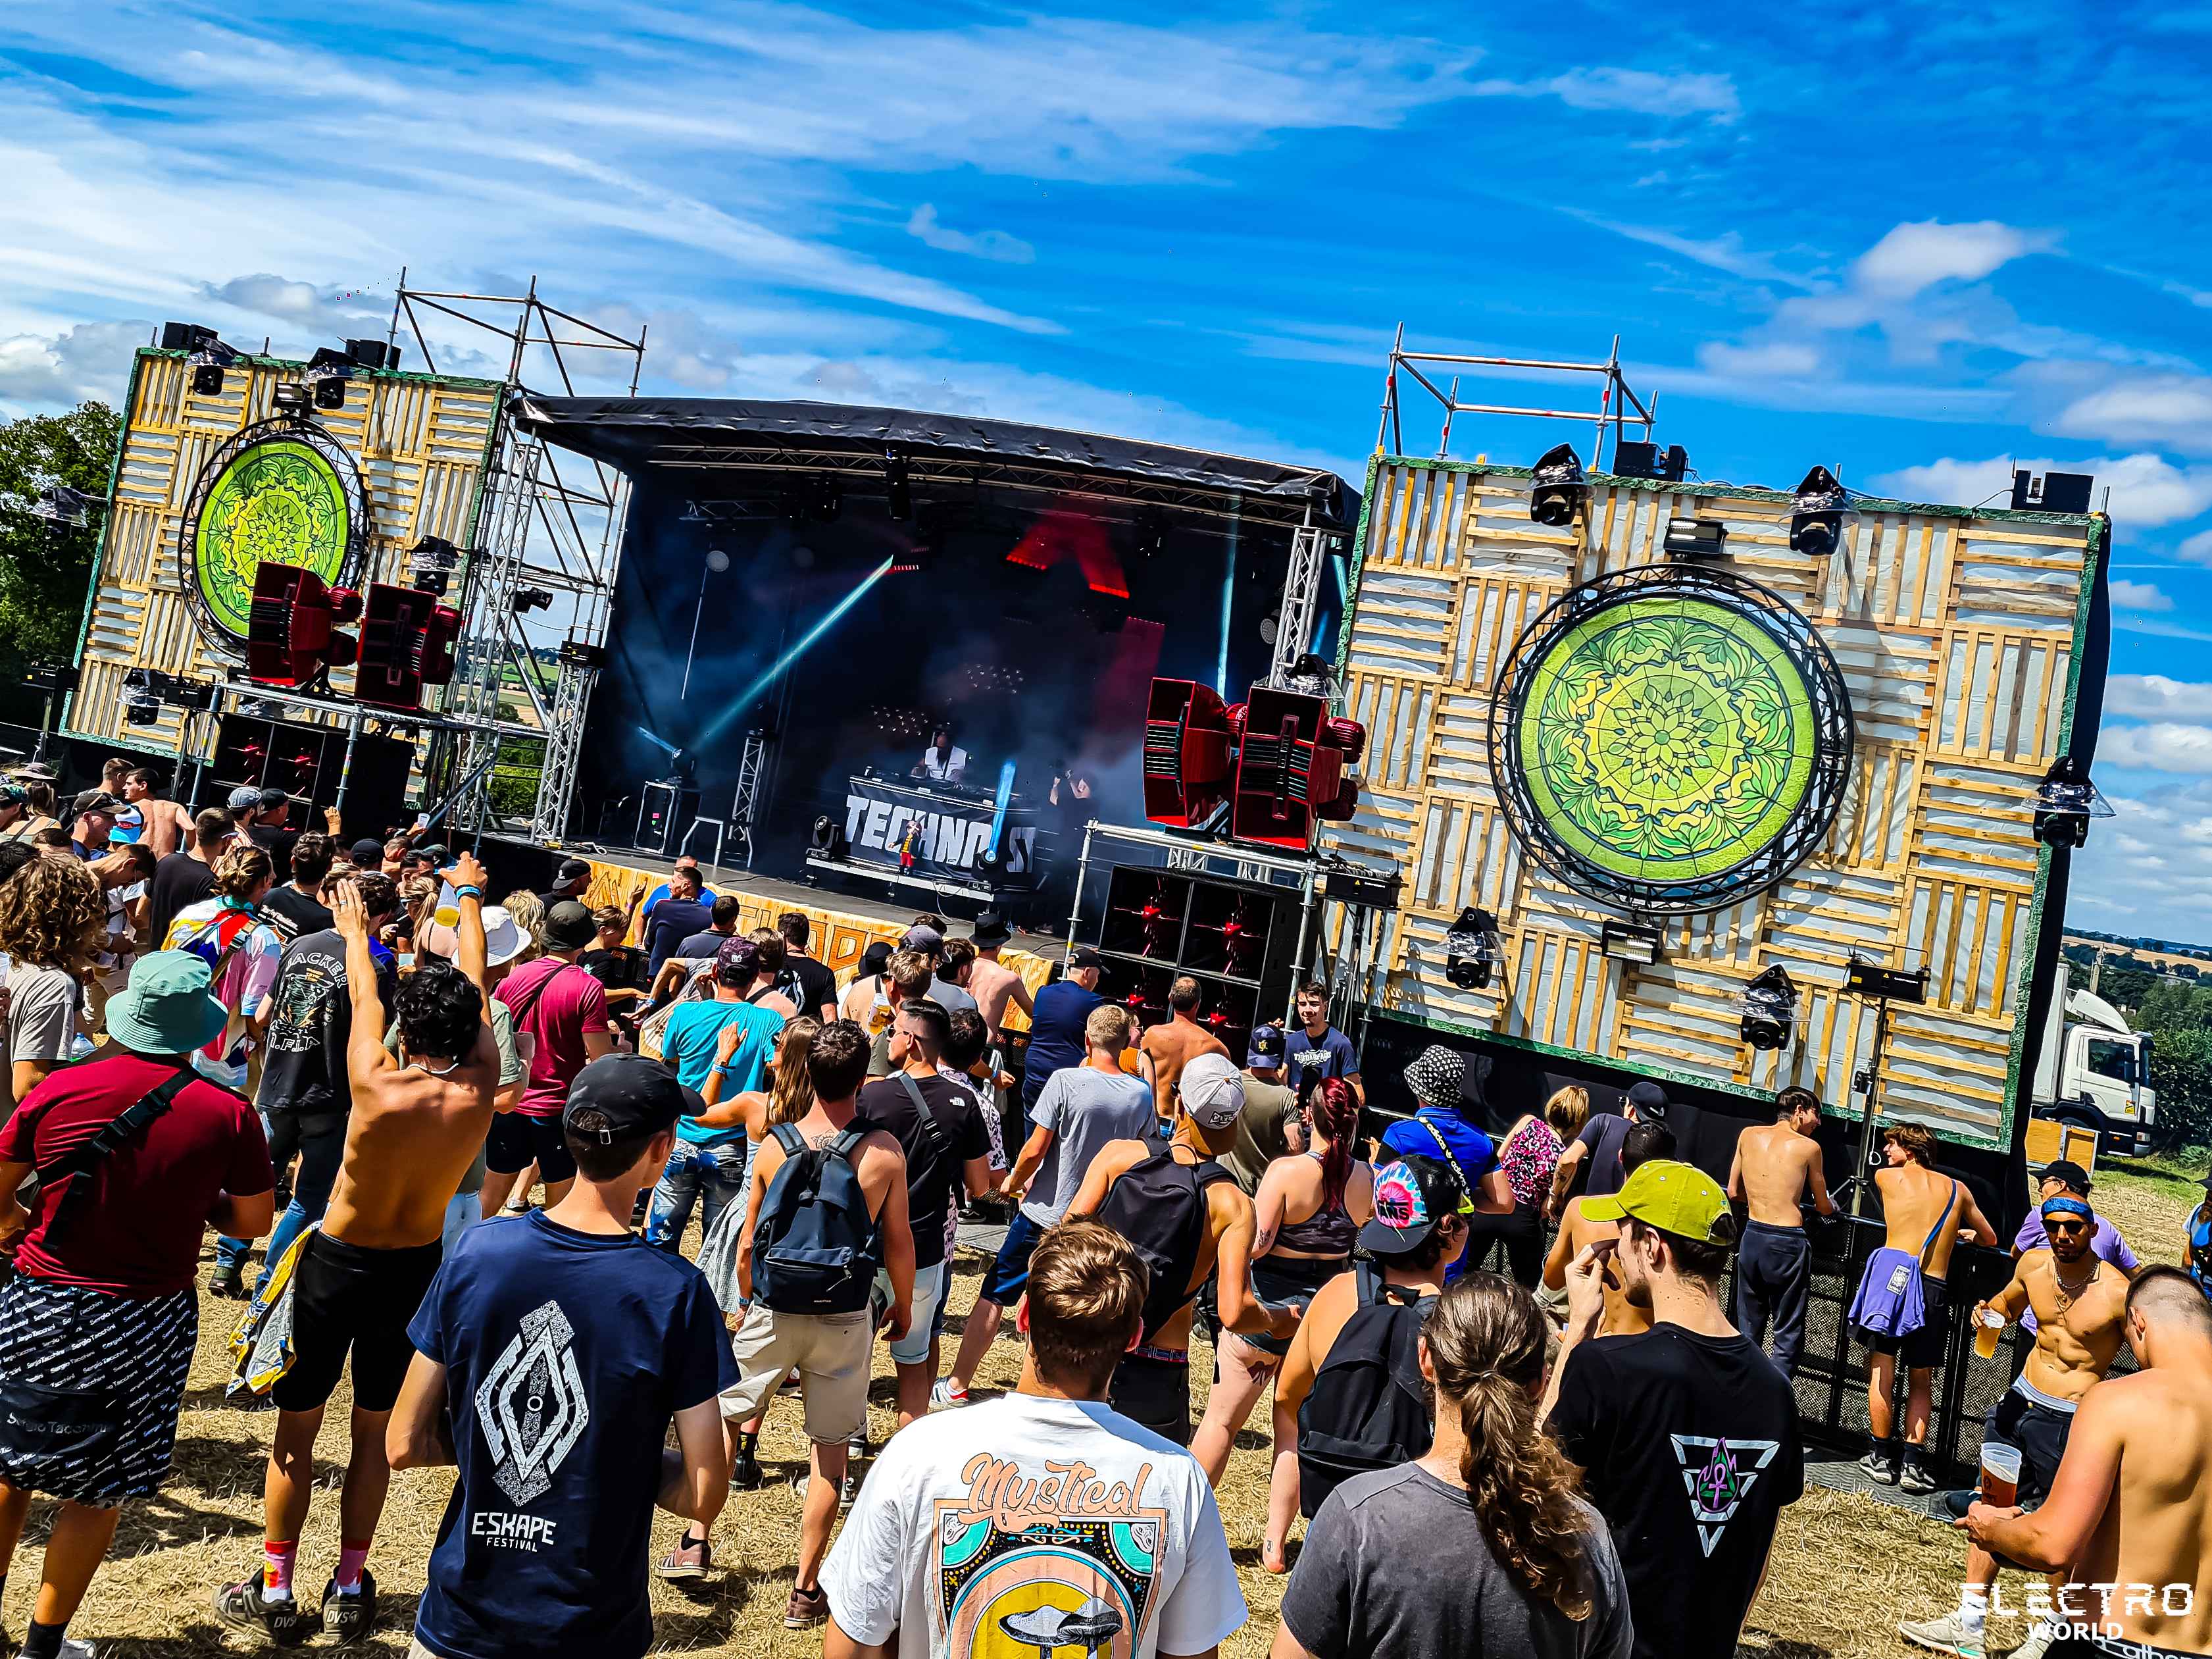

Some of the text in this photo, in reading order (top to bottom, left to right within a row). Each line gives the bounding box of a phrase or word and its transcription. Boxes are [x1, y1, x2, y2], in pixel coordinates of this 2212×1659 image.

[845, 795, 992, 868] TECHNO
[1426, 1123, 1445, 1150] adidas
[72, 1324, 116, 1350] Sergio Tacchini
[103, 1320, 146, 1349] Sergio Tacchini
[958, 1452, 1152, 1533] Mystical
[472, 1512, 557, 1545] ESKAPE
[487, 1537, 537, 1552] FESTIVAL
[327, 1610, 350, 1623] DVS
